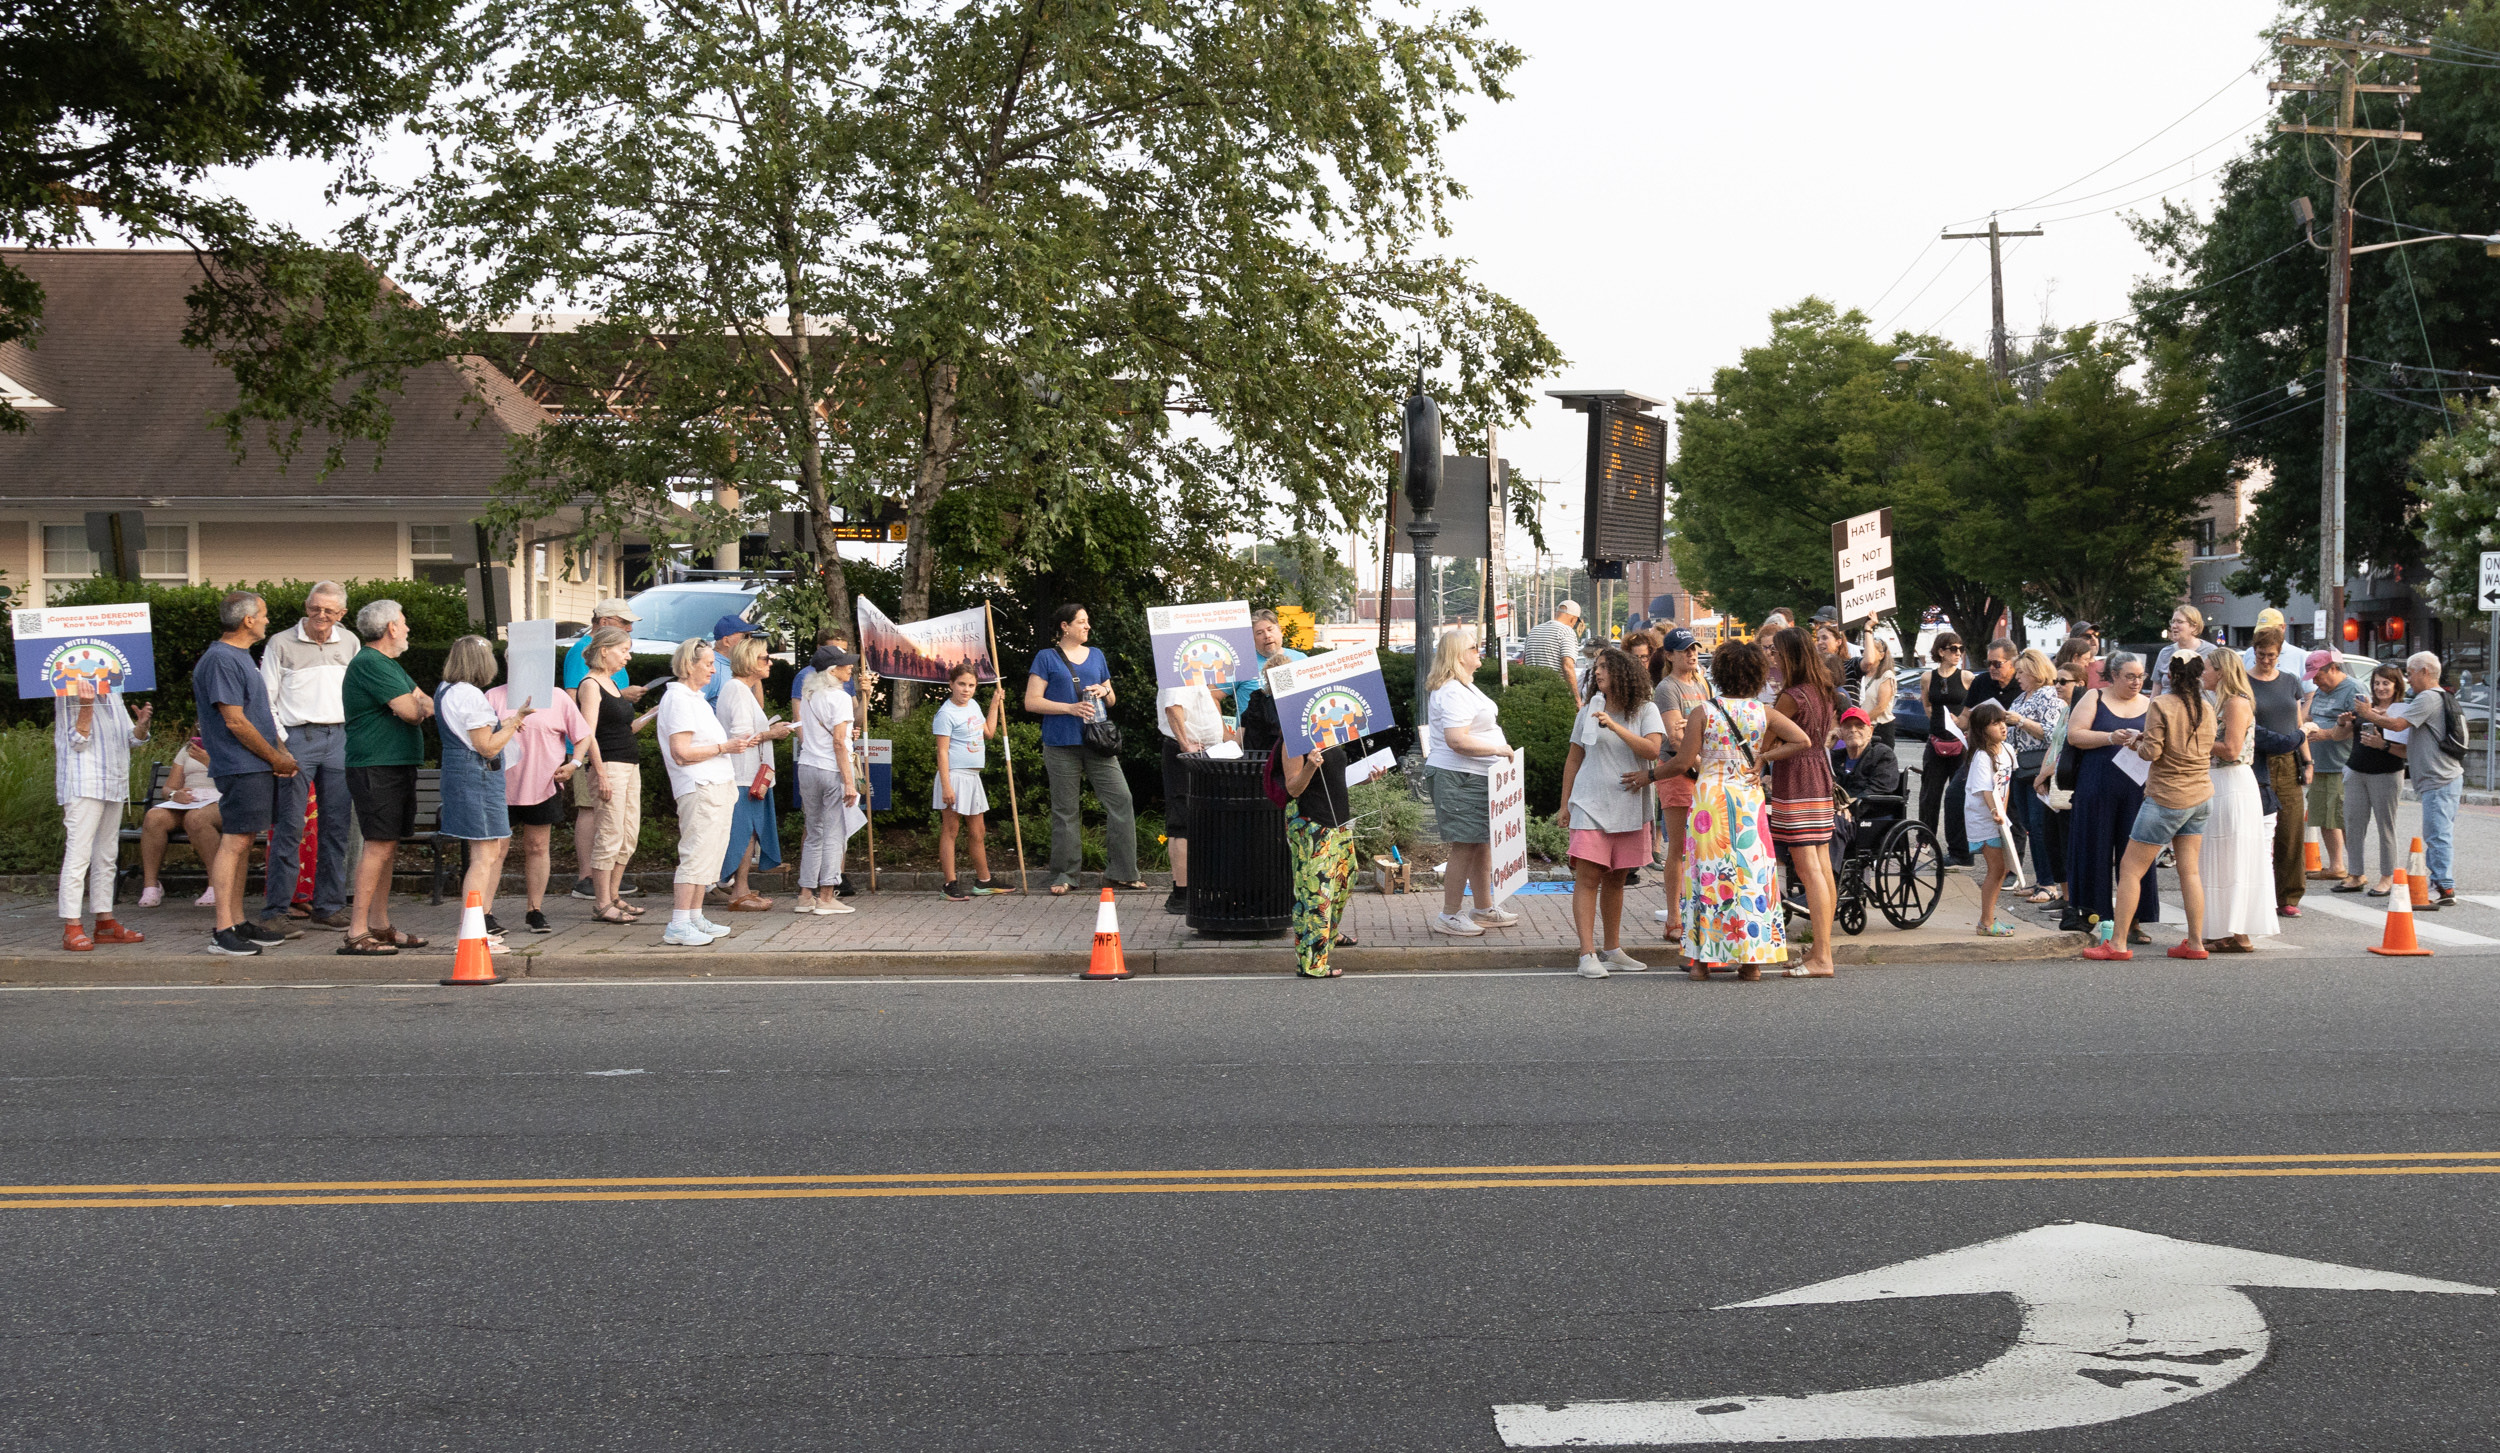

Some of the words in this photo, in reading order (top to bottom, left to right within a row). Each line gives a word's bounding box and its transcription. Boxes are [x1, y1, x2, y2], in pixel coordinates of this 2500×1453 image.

[894, 525, 903, 535] 3
[1851, 521, 1876, 538] HATE
[1842, 557, 1851, 569] IS
[1862, 547, 1882, 564] NOT
[2485, 557, 2500, 571] ON
[1856, 570, 1874, 585] THE
[2484, 573, 2500, 586] WA
[1845, 587, 1887, 610] ANSWER
[101, 611, 147, 619] DERECHOS!
[107, 619, 133, 627] Rights
[64, 637, 89, 648] WITH
[1188, 632, 1206, 642] WITH
[43, 644, 65, 668] STAND
[90, 638, 132, 676] IMMIGRANTS!
[1174, 639, 1189, 660] STAND
[1207, 633, 1240, 667] IMMIGRANTS!
[1173, 663, 1180, 673] WE
[1296, 664, 1324, 677] ¡Conozca
[1337, 649, 1374, 664] DERECHOS!
[1309, 671, 1327, 680] Know
[1327, 666, 1343, 674] Your
[1343, 660, 1364, 669] Rights
[41, 668, 50, 681] WE
[1313, 686, 1332, 699] WITH
[1333, 684, 1373, 717] IMMIGRANTS!
[1301, 697, 1315, 722] STAND
[1301, 724, 1308, 737] WE
[1496, 768, 1516, 793] Due
[1490, 787, 1522, 820] Process
[1494, 829, 1502, 848] Is
[1505, 817, 1521, 842] Not
[1493, 850, 1526, 889] Optional
